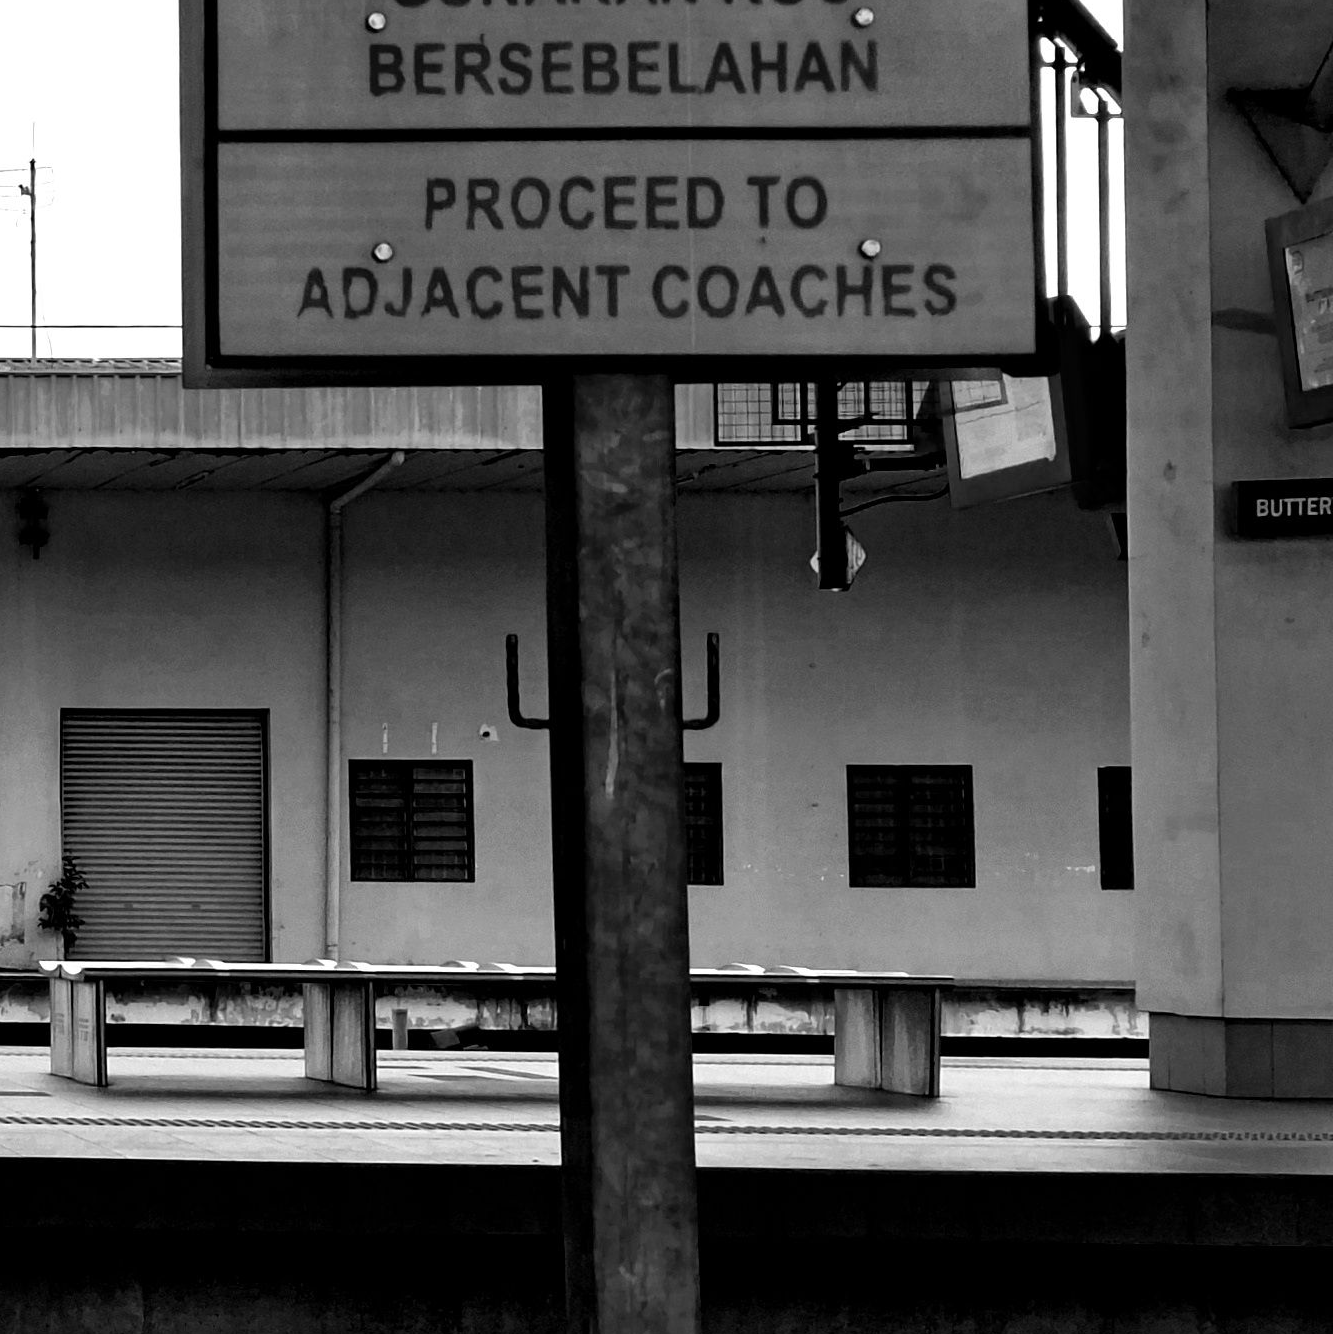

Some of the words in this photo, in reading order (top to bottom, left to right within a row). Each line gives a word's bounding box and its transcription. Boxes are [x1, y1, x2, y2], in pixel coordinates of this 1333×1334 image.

[368, 40, 879, 97] BERSEBELAHAN
[424, 175, 726, 231] PROCEED
[747, 175, 829, 229] TO
[297, 265, 631, 320] ADJACENT
[651, 263, 959, 319] COACHES
[1256, 496, 1333, 518] BUTTER
